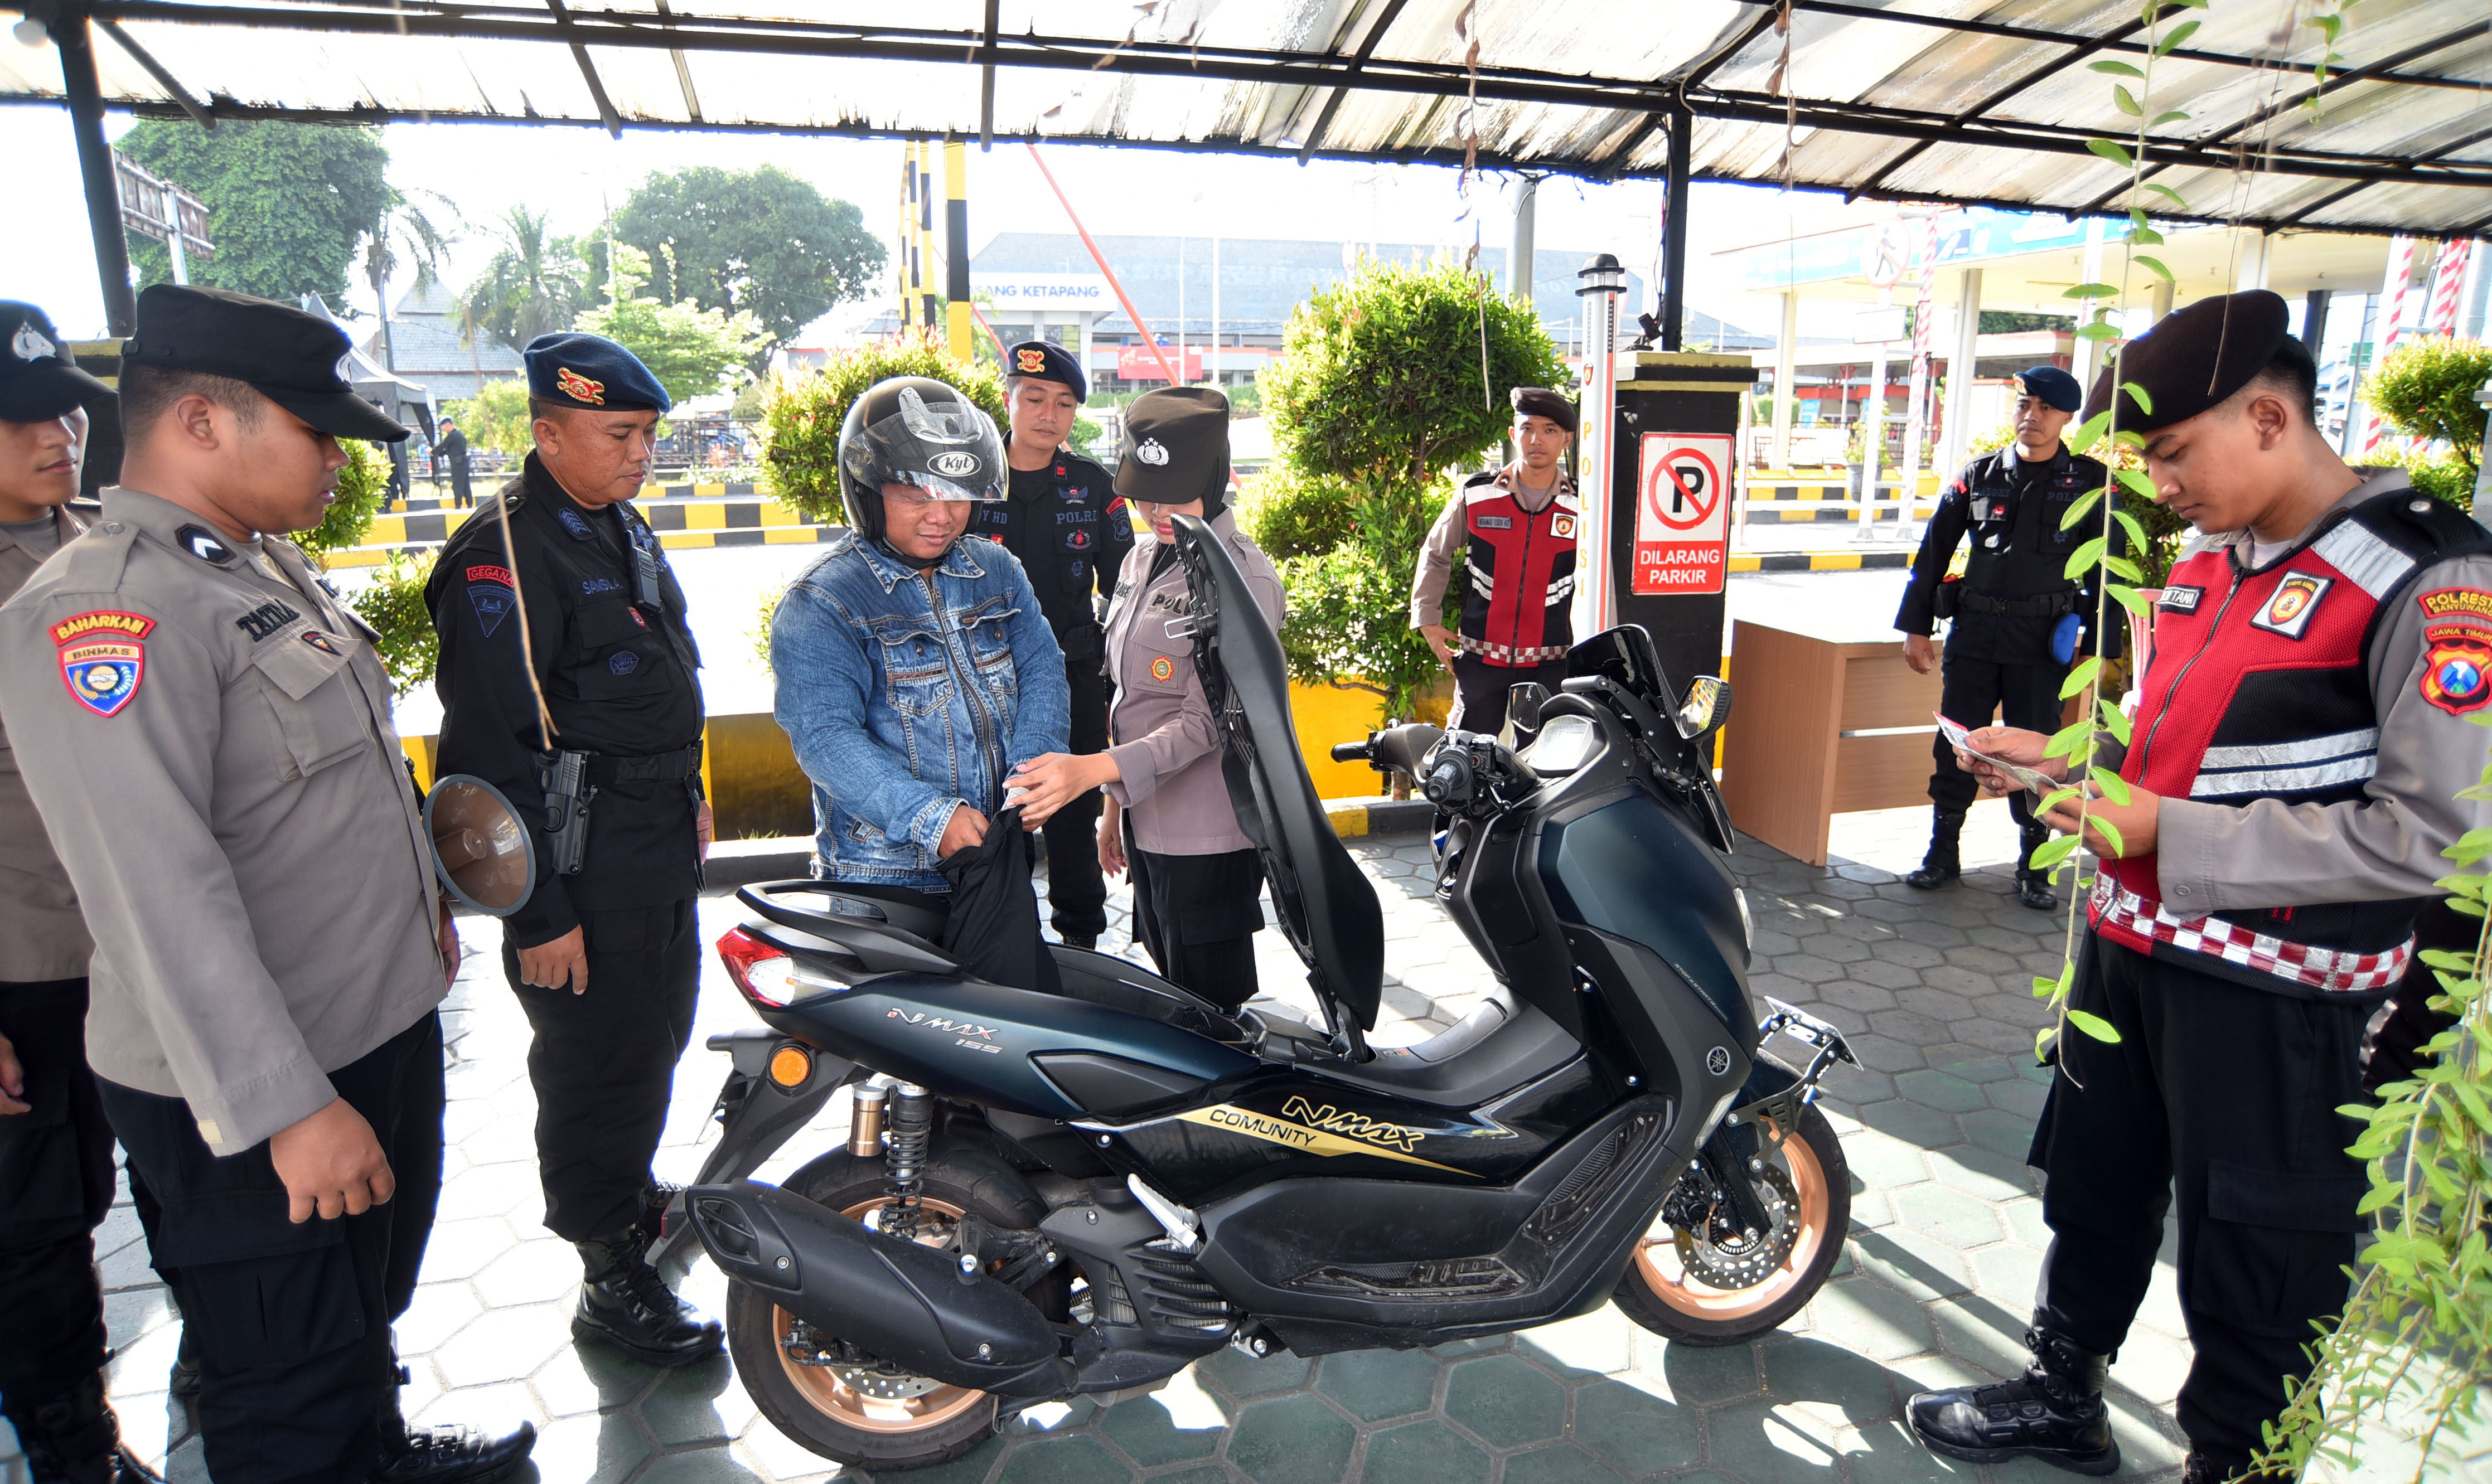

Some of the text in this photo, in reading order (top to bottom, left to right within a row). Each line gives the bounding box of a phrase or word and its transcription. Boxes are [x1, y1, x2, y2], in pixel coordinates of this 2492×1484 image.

[1023, 285, 1100, 297] KETAPANG
[943, 456, 971, 472] Kyt
[1580, 421, 1592, 596] POLISI
[1056, 510, 1097, 525] POLRI
[1641, 549, 1720, 565] DILARANG
[471, 569, 514, 584] GEGANA
[1649, 570, 1706, 584] PARKIR
[56, 615, 146, 639] BAHARKAM
[2431, 628, 2460, 637] JAWA
[72, 647, 130, 660] BINMAS
[955, 1038, 1003, 1054] 155
[1209, 1108, 1318, 1147] COMUNITY
